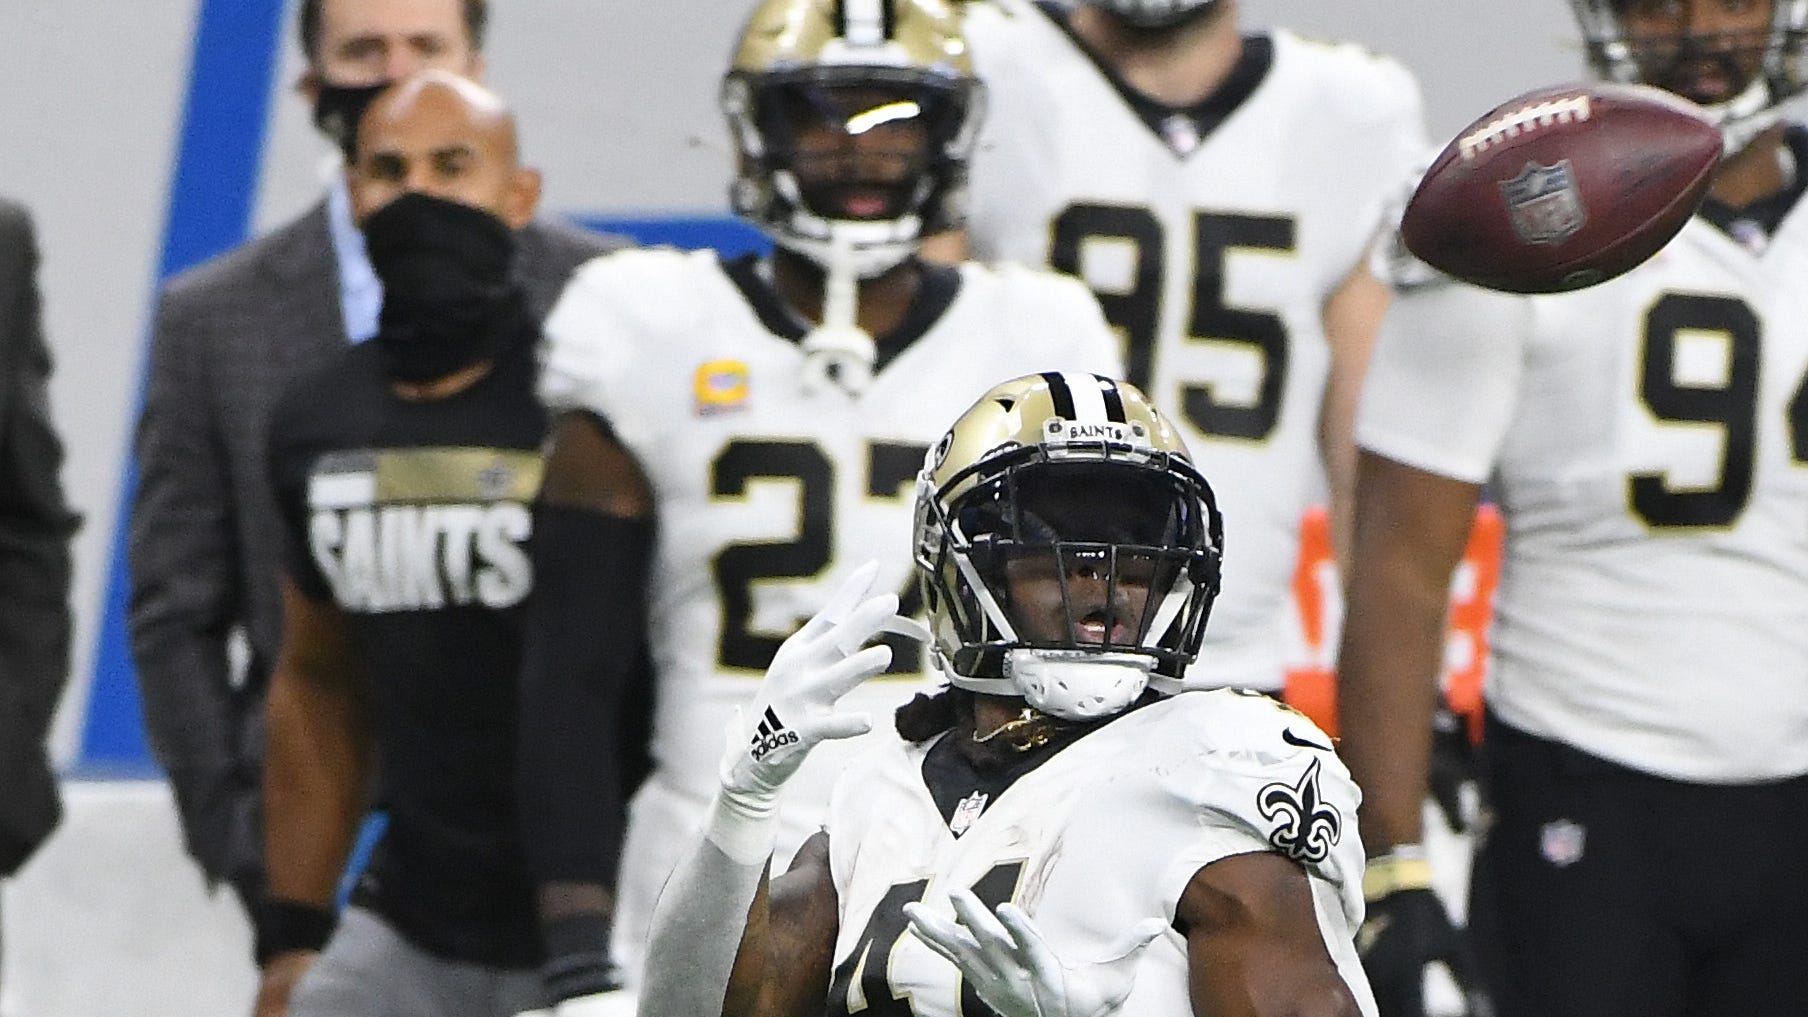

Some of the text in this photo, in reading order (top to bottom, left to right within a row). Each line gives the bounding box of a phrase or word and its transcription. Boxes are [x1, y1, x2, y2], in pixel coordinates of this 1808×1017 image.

[1047, 200, 1298, 444] 95
[1070, 424, 1123, 440] SAINTS
[309, 502, 534, 613] SAINTS
[750, 731, 799, 762] adidas
